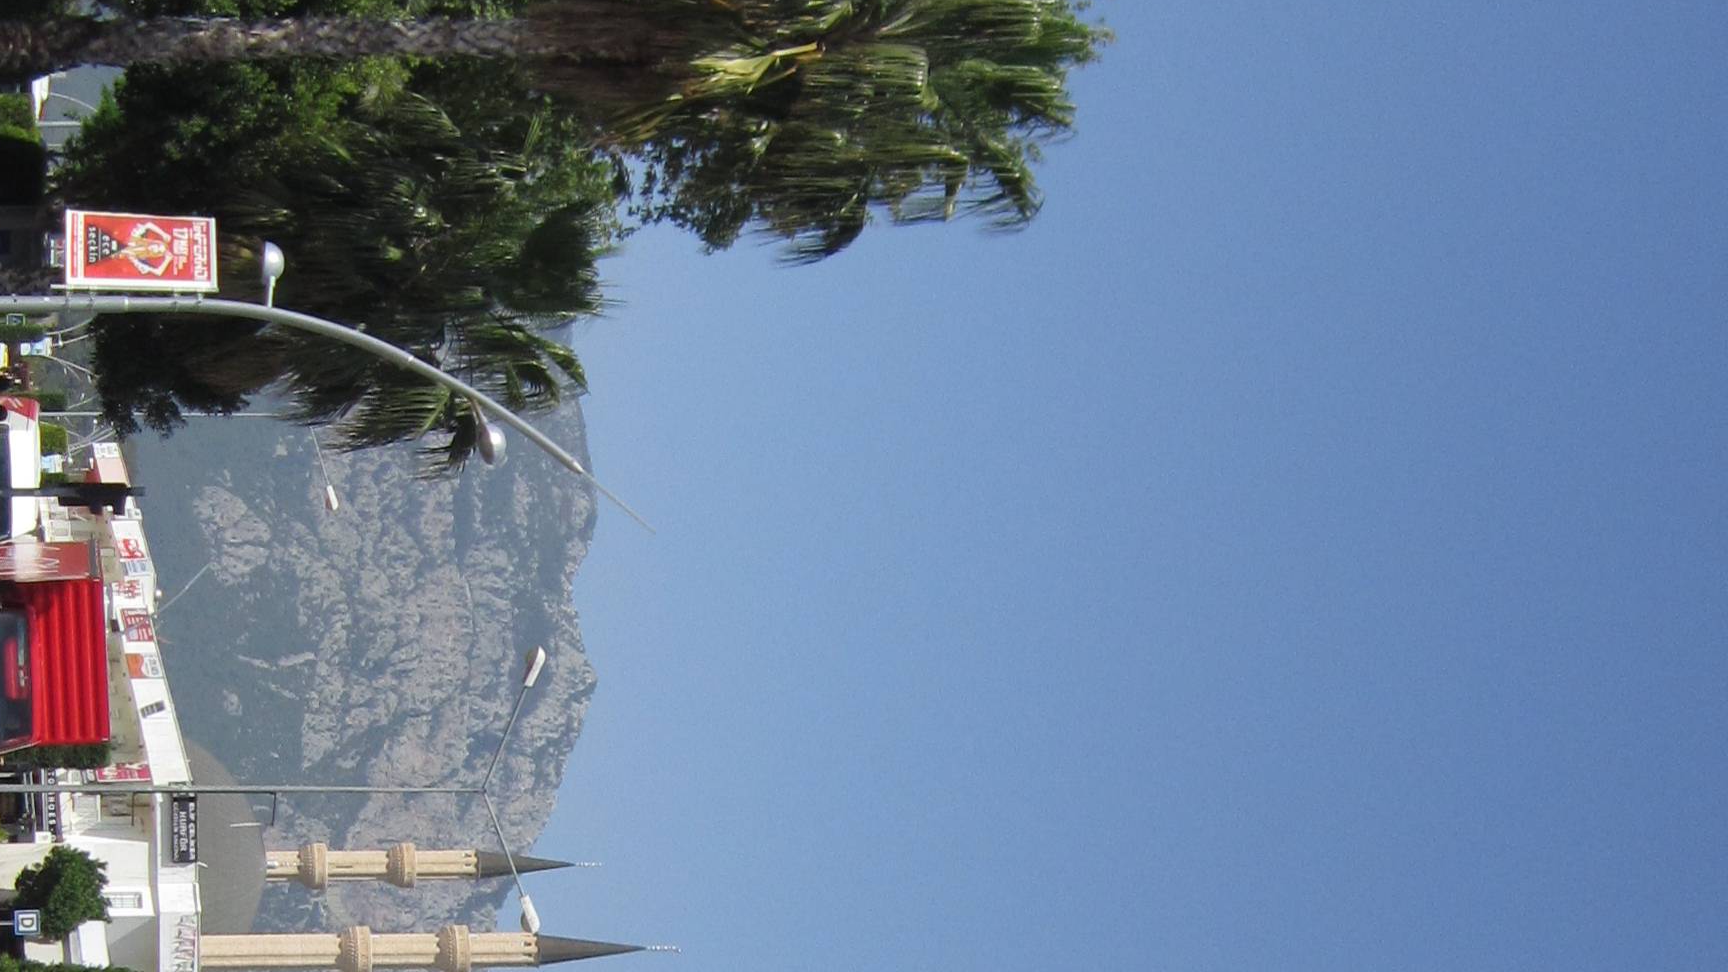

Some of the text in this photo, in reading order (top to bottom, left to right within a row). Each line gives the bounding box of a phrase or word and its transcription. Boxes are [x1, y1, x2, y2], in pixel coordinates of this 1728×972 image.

[172, 227, 188, 239] 17
[101, 235, 110, 255] ece
[20, 916, 34, 929] D
